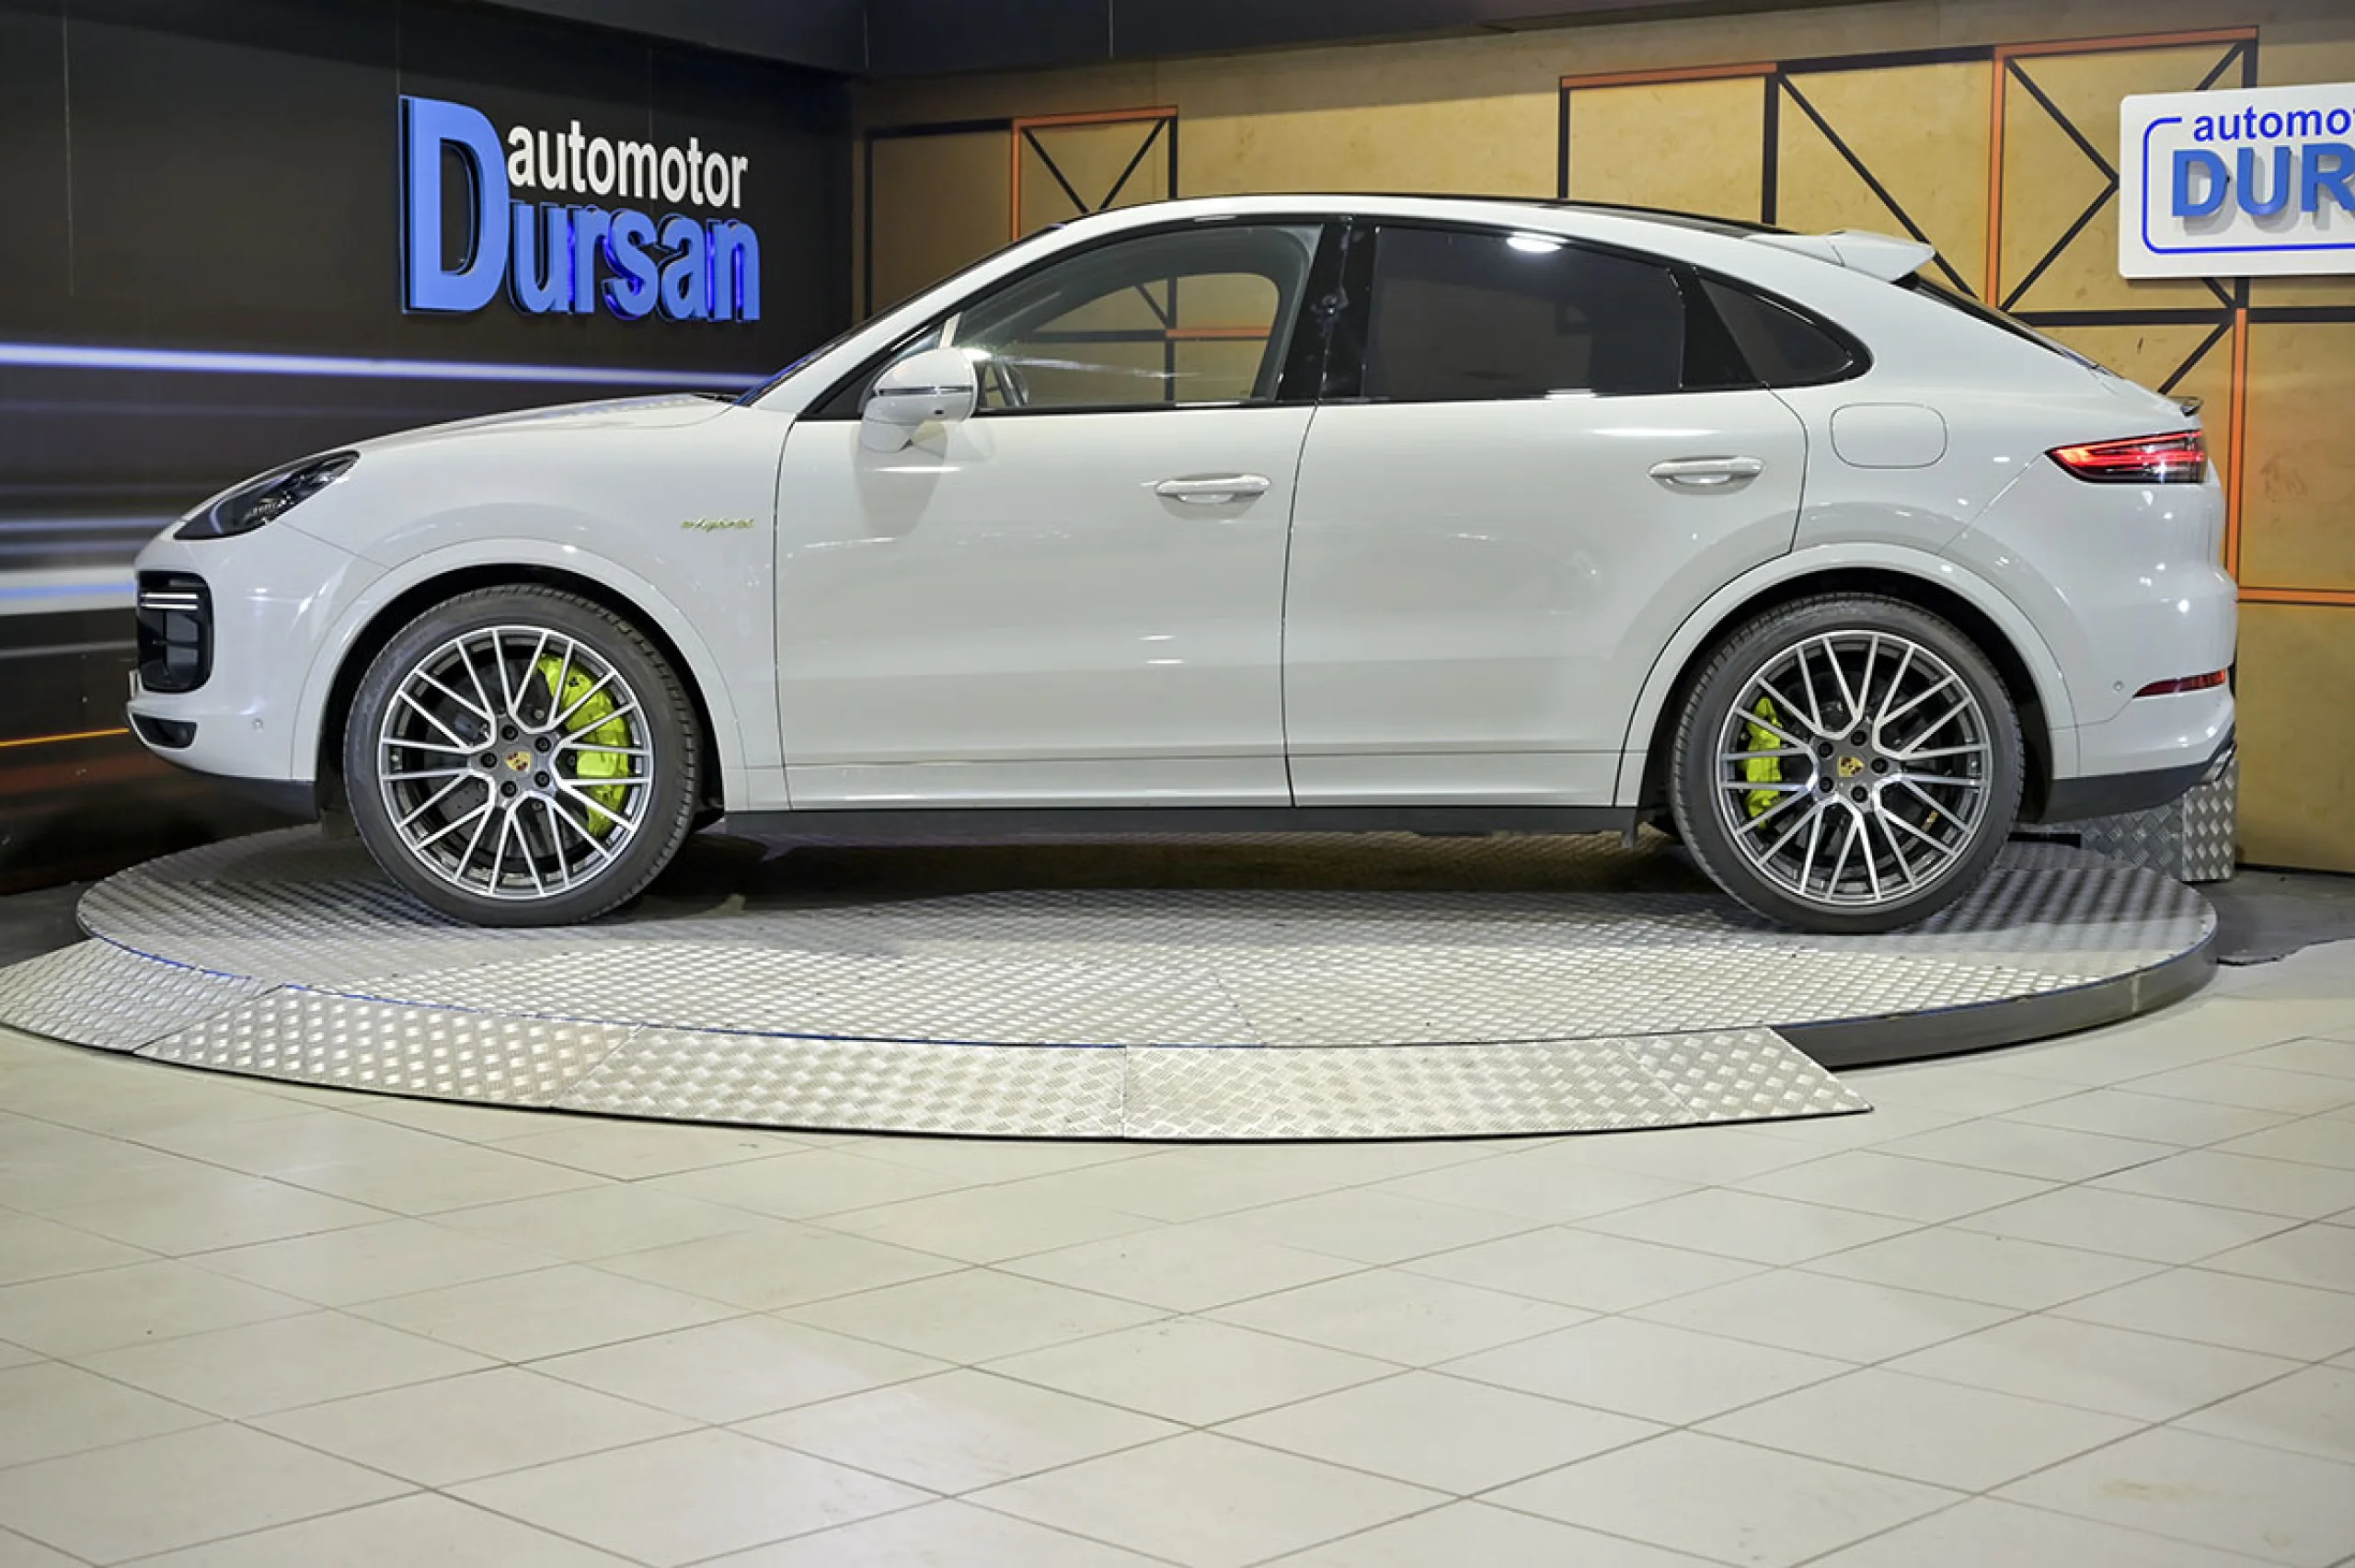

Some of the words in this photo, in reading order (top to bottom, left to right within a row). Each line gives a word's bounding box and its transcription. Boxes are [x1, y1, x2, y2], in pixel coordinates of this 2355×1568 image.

[507, 120, 749, 209] automotor
[2193, 105, 2355, 142] automo
[398, 94, 760, 322] Dursan
